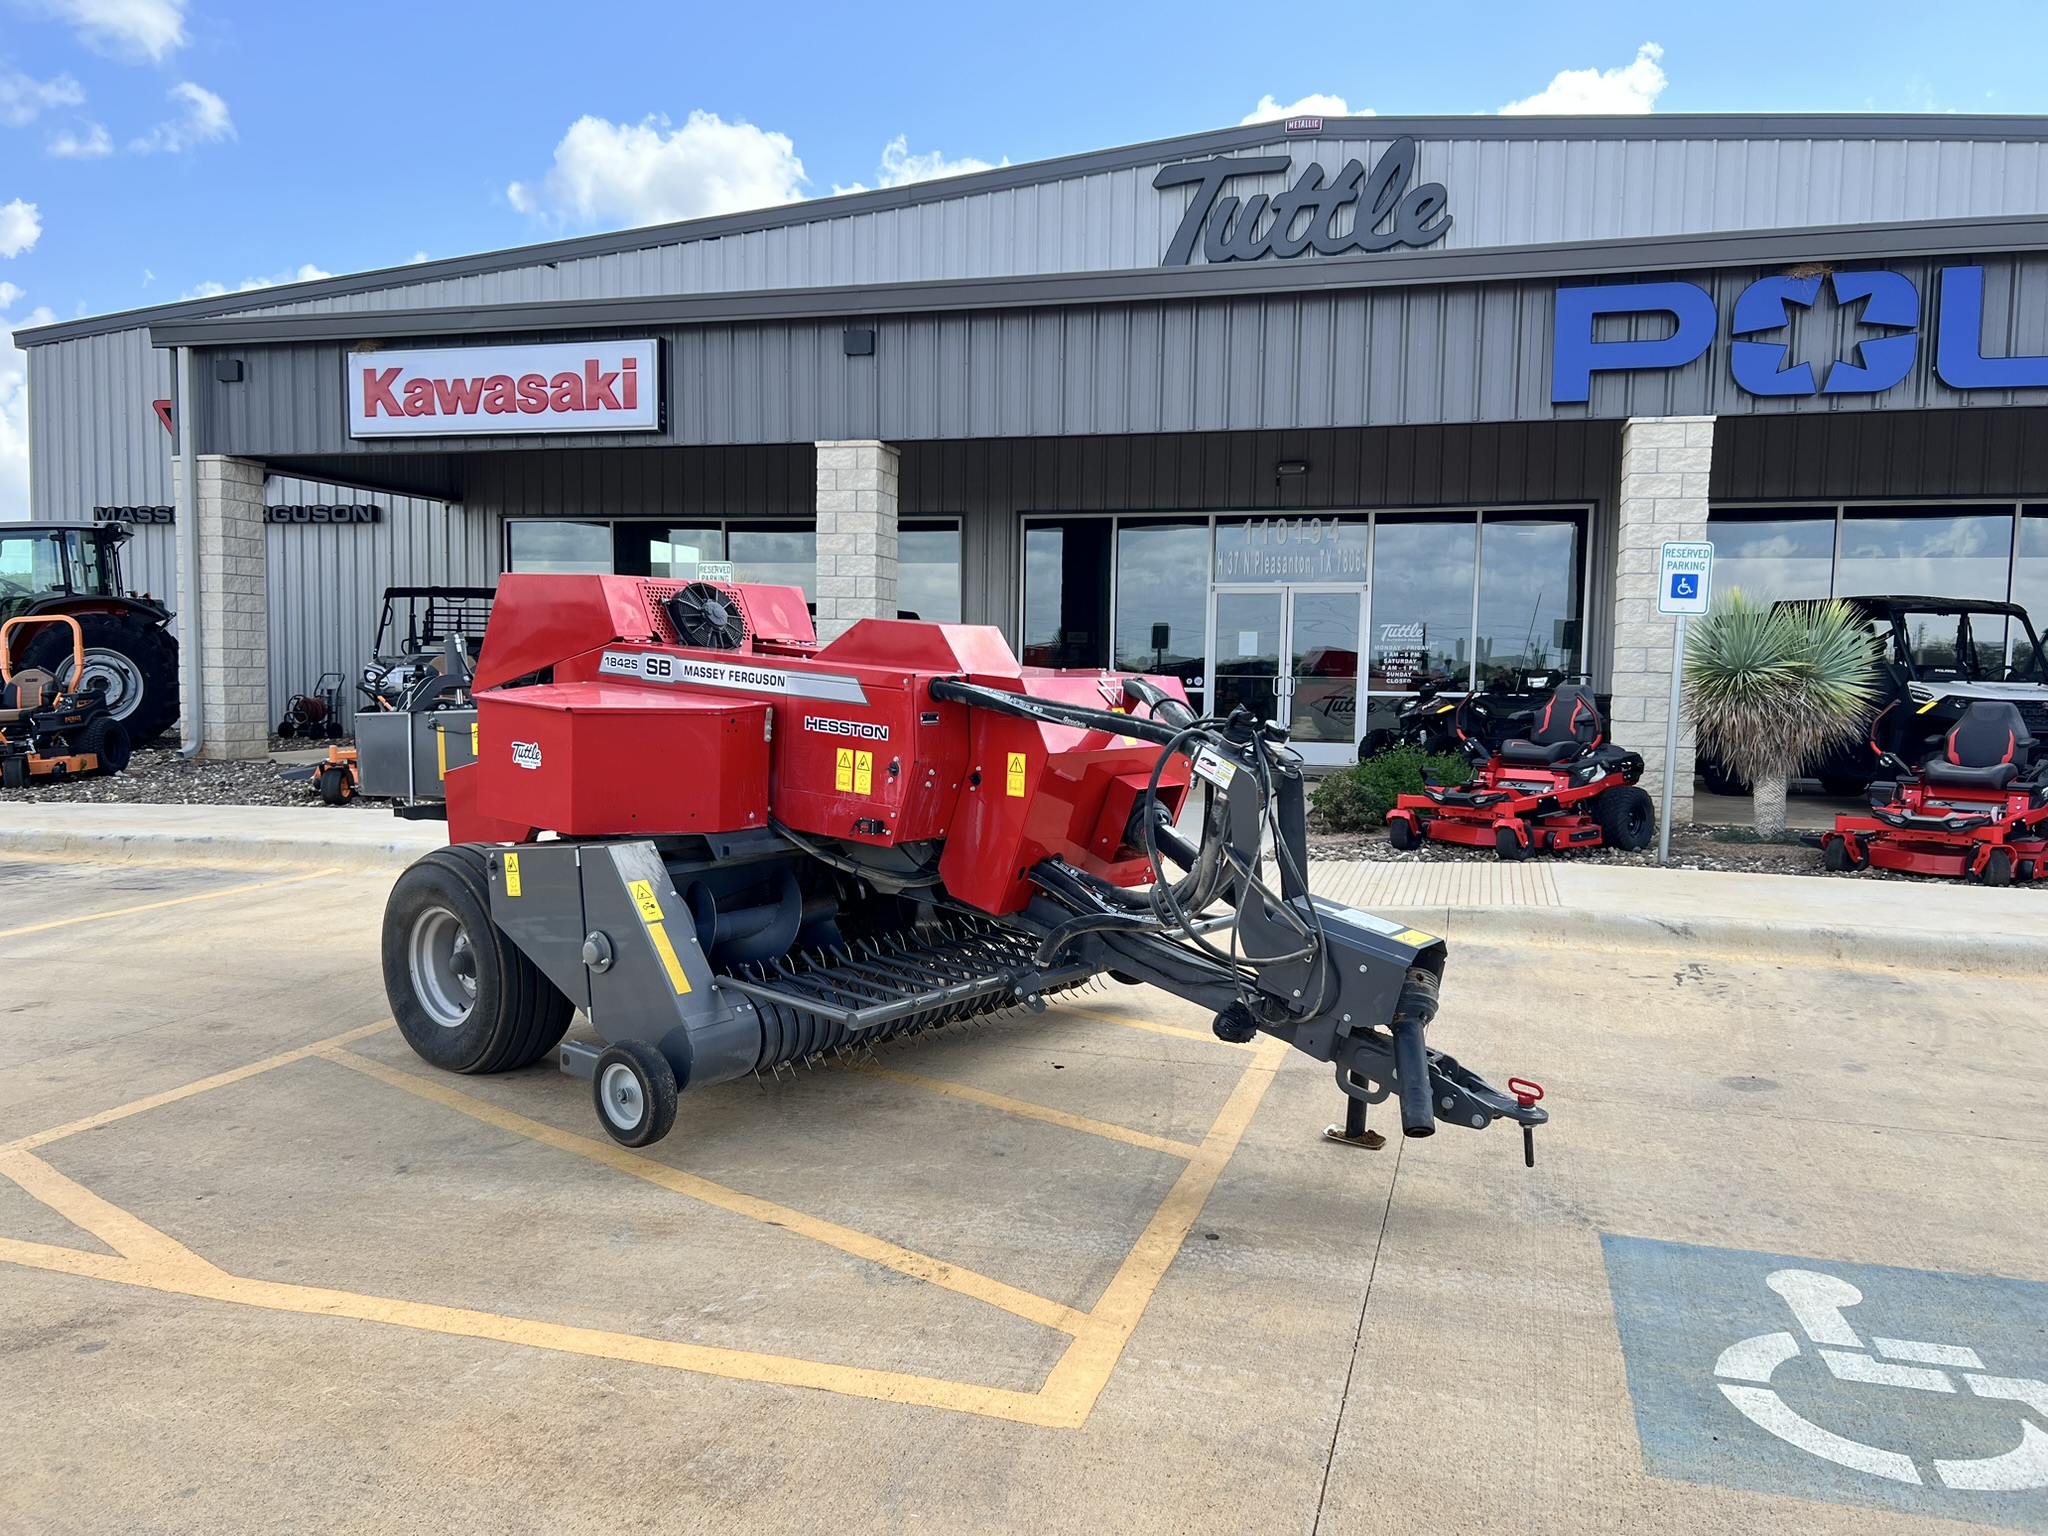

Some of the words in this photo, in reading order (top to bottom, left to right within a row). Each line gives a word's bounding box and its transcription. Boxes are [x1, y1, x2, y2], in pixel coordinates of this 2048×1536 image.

[1288, 119, 1319, 129] METALLIC
[1152, 136, 1453, 266] Tuttle
[1551, 265, 2048, 403] POL
[363, 357, 637, 418] Kawasaki
[93, 505, 175, 523] MASS
[1243, 517, 1340, 545] 110194
[1228, 551, 1239, 575] 37
[1243, 551, 1250, 575] N
[1254, 550, 1315, 578] Pleasanton,
[1319, 549, 1332, 574] TX
[1337, 549, 1366, 574] 78064
[1665, 548, 1710, 559] RESERVED
[699, 565, 731, 574] RESERVED
[1667, 561, 1706, 571] PARKING
[1380, 622, 1424, 642] Tuttle
[603, 656, 638, 669] 1842S
[646, 658, 672, 676] SB
[683, 664, 726, 681] MASSEY
[728, 670, 785, 687] FERGUSON
[1323, 695, 1376, 718] Tute
[805, 717, 888, 740] HESSTON
[512, 743, 541, 762] Tuttle
